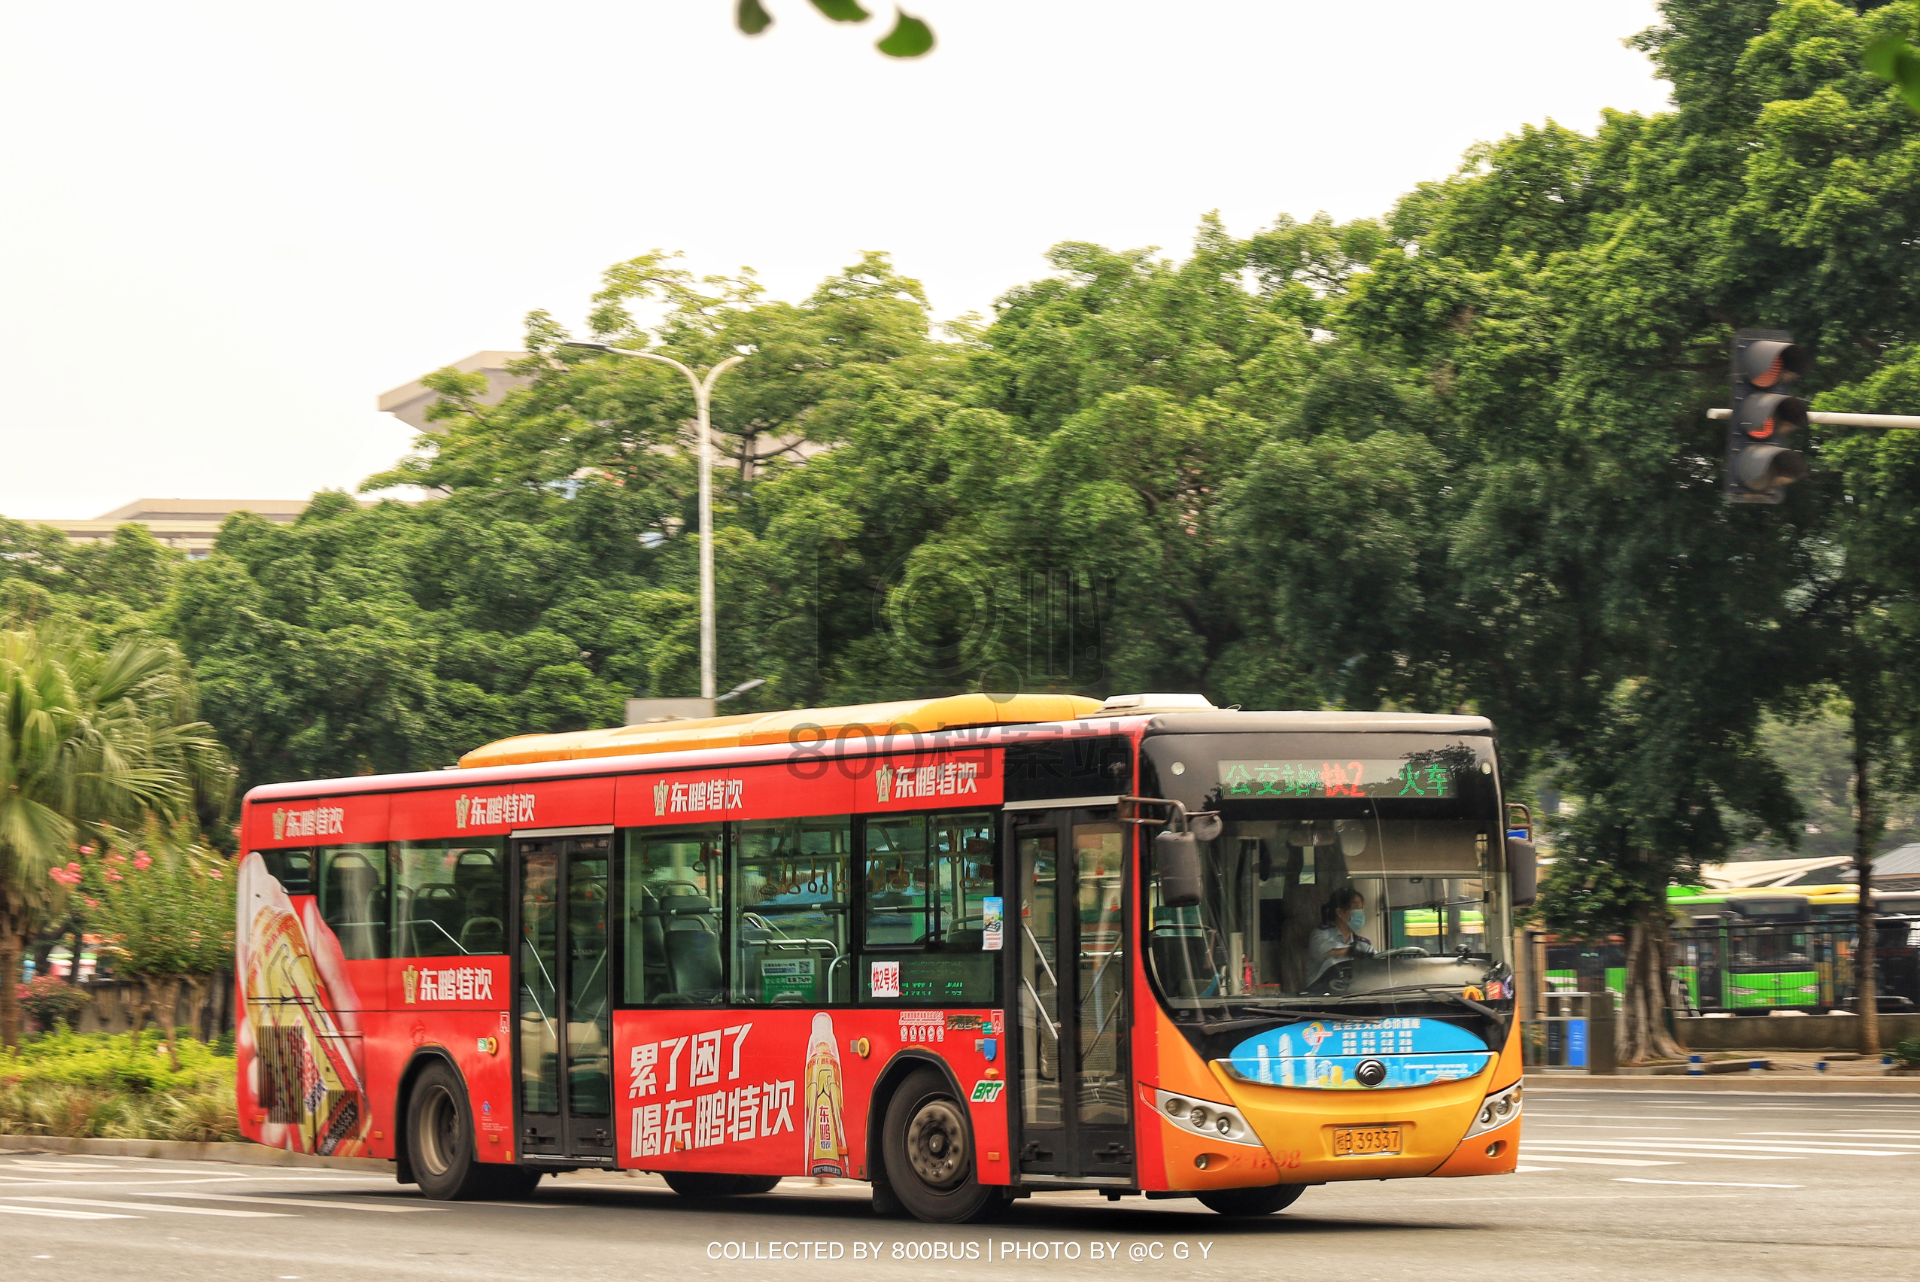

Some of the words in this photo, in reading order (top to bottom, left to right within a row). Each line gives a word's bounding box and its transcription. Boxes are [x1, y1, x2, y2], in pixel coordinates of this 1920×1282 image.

[670, 778, 743, 813] 东鹏特饮
[895, 762, 978, 798] 东鹏特饮
[1226, 763, 1310, 797] 公交站
[1320, 761, 1366, 797] 快2
[1399, 763, 1449, 797] 火车
[286, 807, 344, 837] 东鹏特饮
[470, 793, 535, 825] 东鹏特饮
[419, 967, 493, 1000] 东鹏特饮
[872, 966, 899, 992] 快2号线
[628, 1022, 753, 1099] 累了困了
[971, 1082, 1004, 1100] BRT
[631, 1078, 795, 1158] 喝东鹏特饮
